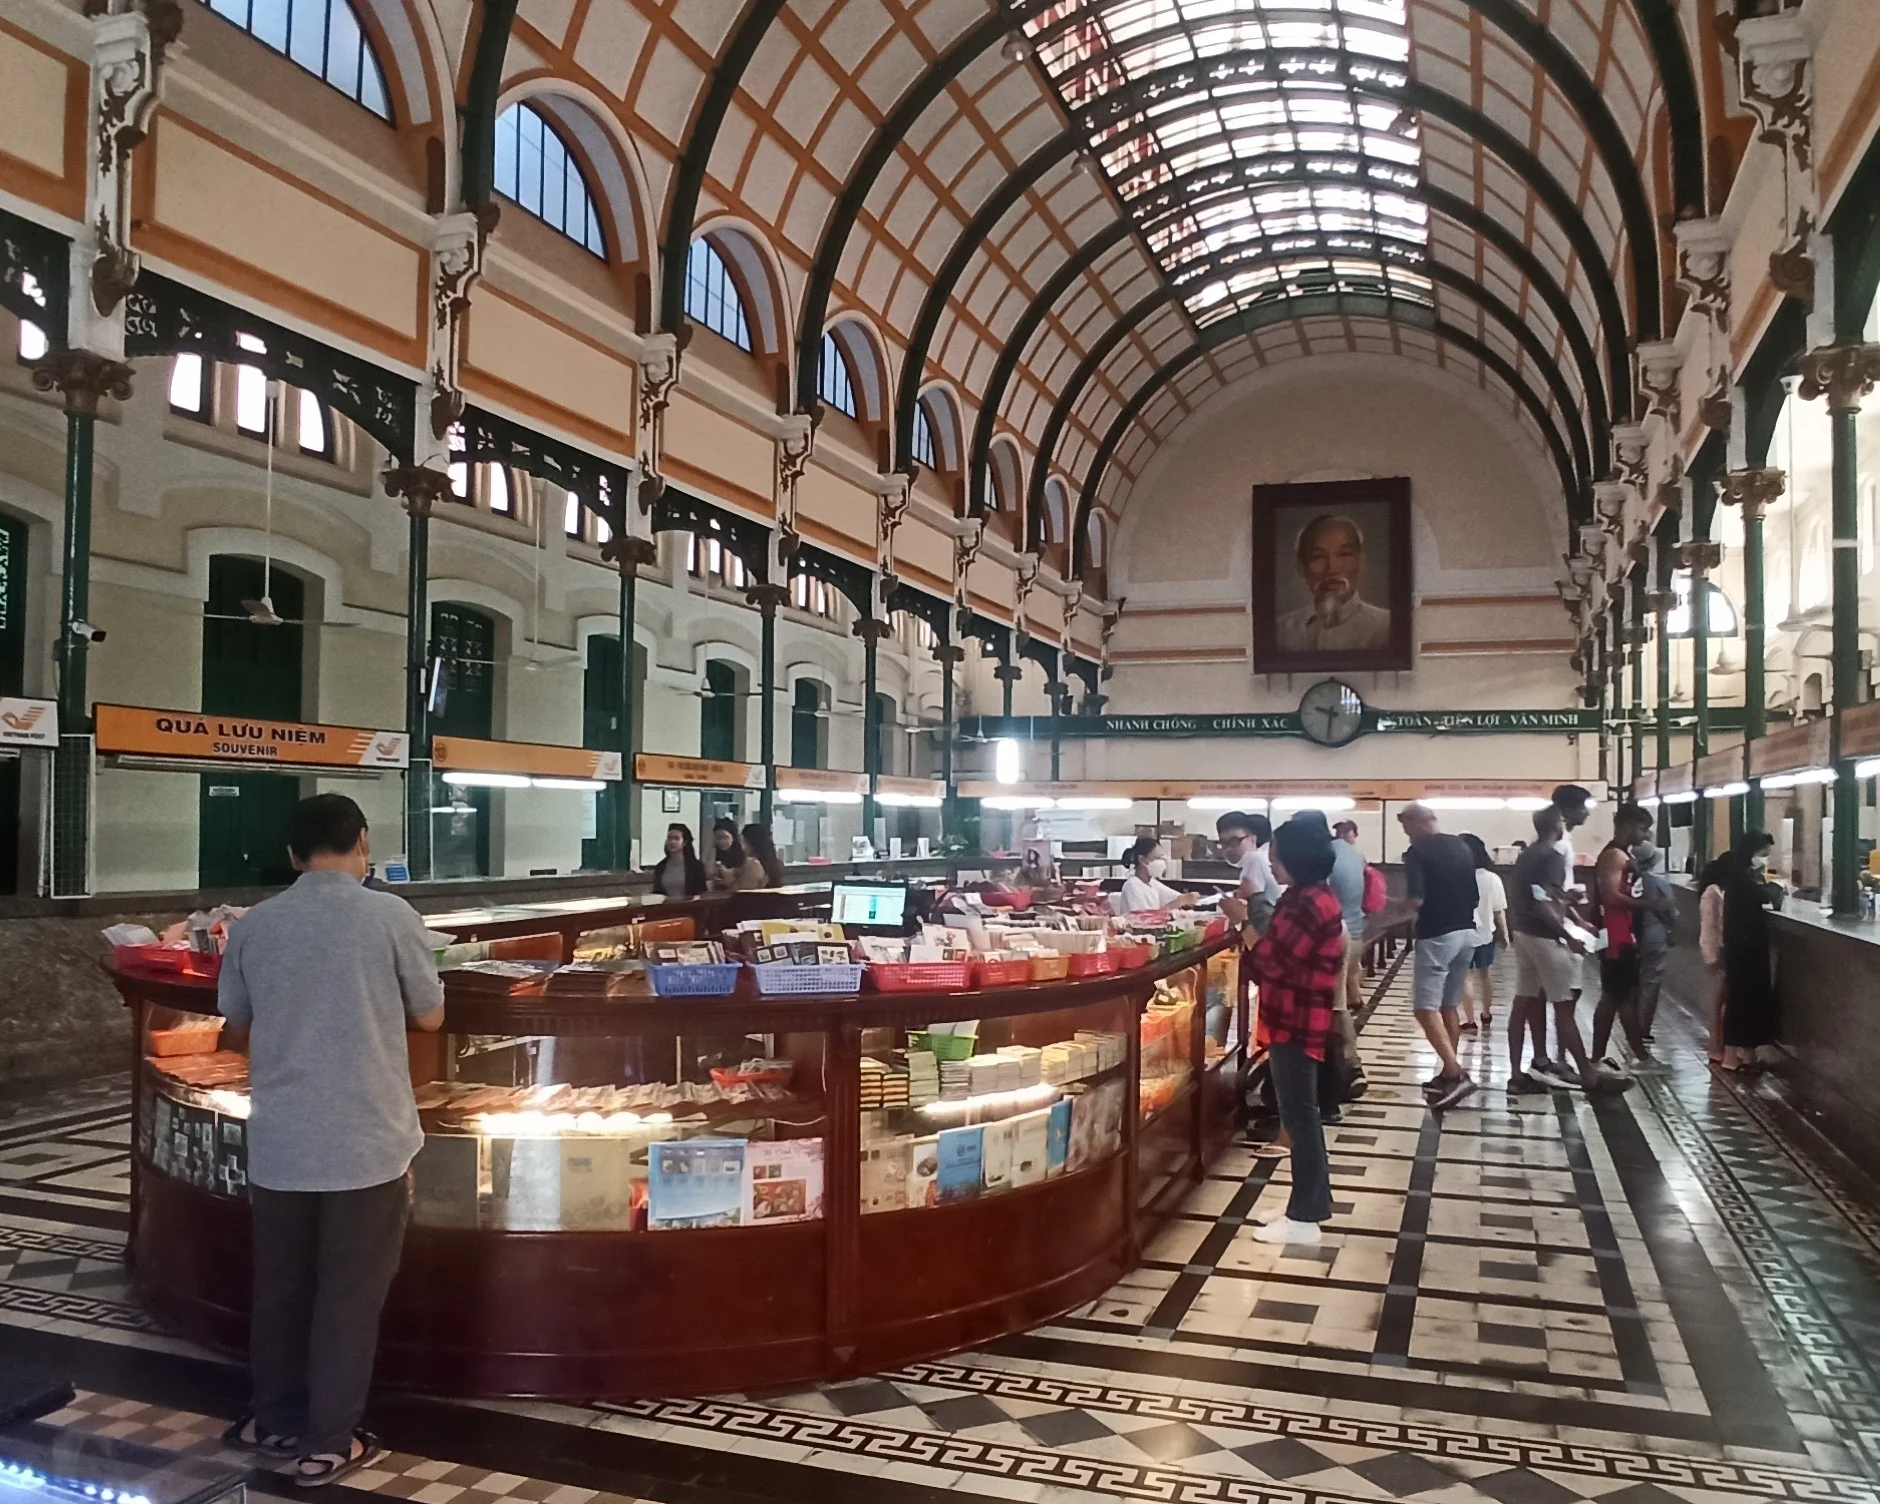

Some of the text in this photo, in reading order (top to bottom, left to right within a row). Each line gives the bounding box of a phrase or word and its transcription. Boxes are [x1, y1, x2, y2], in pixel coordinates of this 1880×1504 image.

[1106, 716, 1289, 731] NHANH CHÓNG CHÍNH XÁC
[1477, 713, 1500, 728] LỢI
[1541, 714, 1579, 726] MINH
[218, 722, 264, 740] LƯU
[271, 727, 326, 746] NIỆM
[213, 741, 278, 757] SOUVENIR
